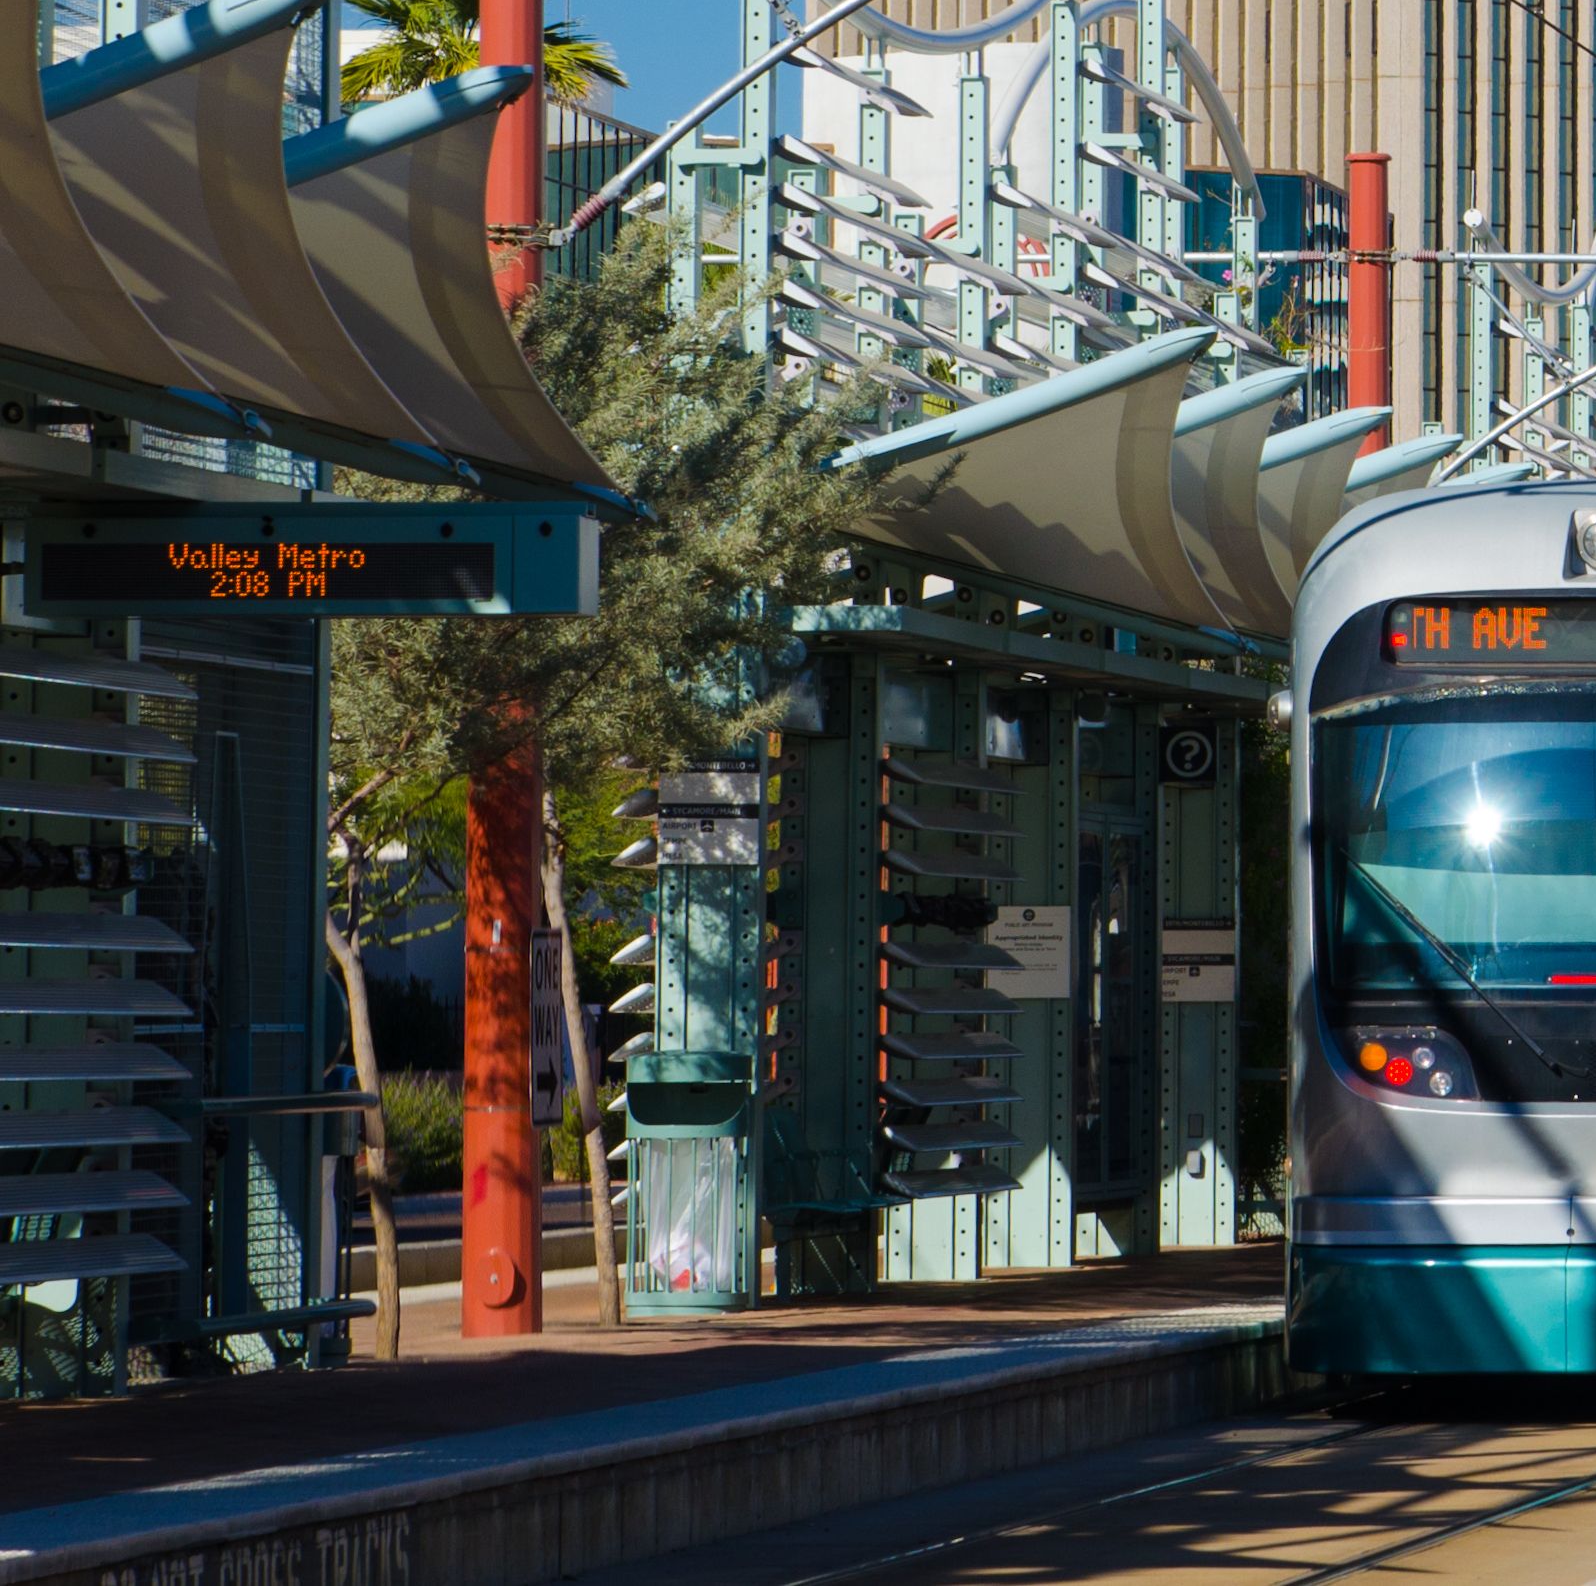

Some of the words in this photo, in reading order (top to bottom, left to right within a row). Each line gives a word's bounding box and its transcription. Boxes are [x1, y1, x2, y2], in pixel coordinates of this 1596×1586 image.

[168, 542, 260, 570] Valley
[277, 542, 366, 570] Metro
[210, 570, 270, 597] 2:08
[288, 570, 327, 597] PM
[1472, 607, 1548, 650] AVE
[662, 821, 697, 831] AIRPORT
[534, 944, 559, 991] ONE
[534, 1005, 560, 1048] WAY
